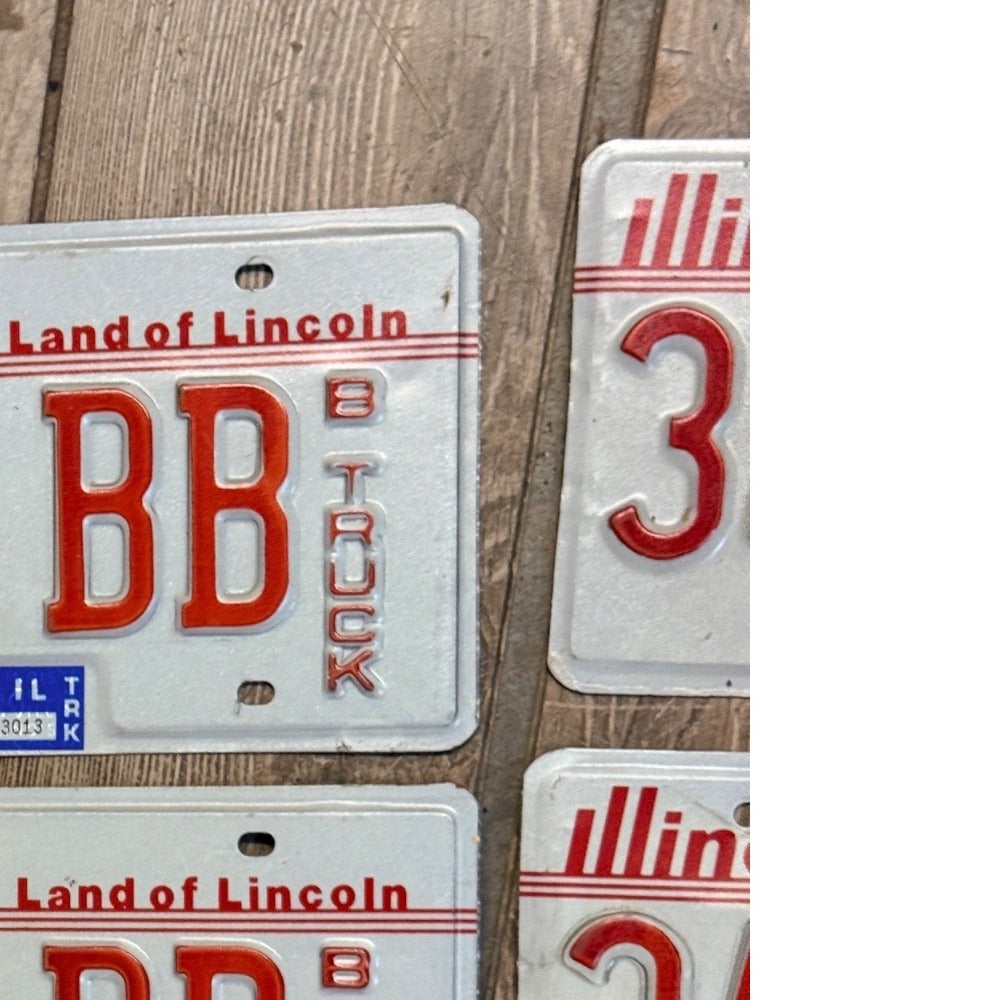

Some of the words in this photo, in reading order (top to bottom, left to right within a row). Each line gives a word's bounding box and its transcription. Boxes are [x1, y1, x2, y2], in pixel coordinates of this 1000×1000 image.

[621, 173, 750, 269] Illi
[9, 315, 129, 355] Land
[144, 311, 194, 349] of
[213, 304, 408, 348] Lincoln
[325, 377, 375, 420] B
[43, 383, 291, 634] BB
[328, 462, 376, 693] TRUCK
[14, 677, 47, 701] IL
[63, 676, 81, 742] TRK
[563, 785, 750, 880] Illin
[16, 876, 135, 911] Land
[149, 875, 198, 911] of
[217, 876, 409, 912] Lincoln
[320, 946, 371, 989] B
